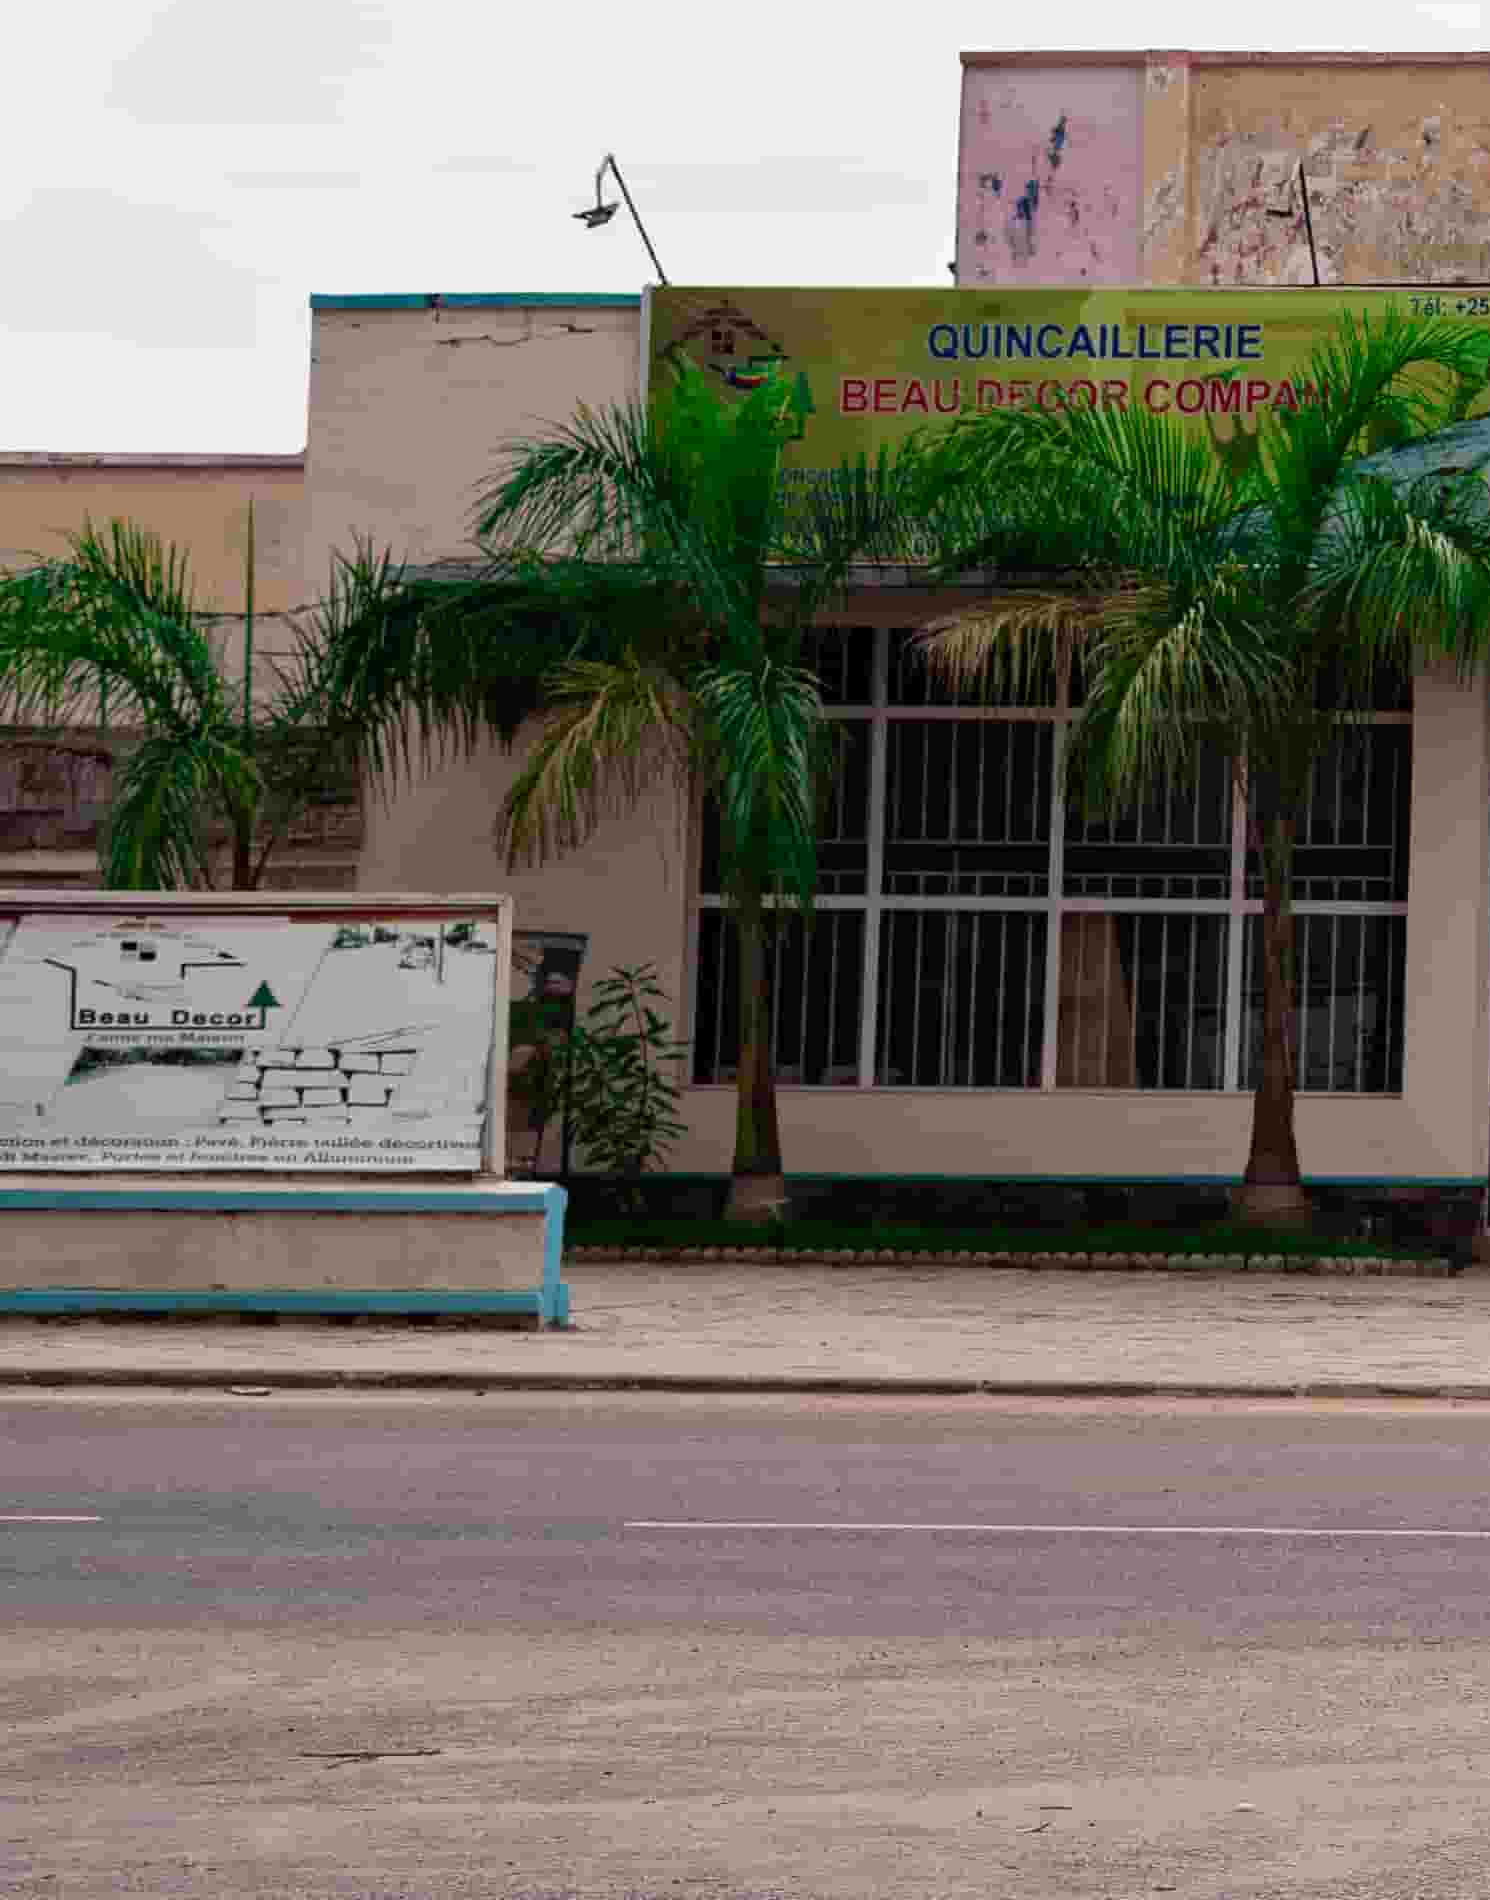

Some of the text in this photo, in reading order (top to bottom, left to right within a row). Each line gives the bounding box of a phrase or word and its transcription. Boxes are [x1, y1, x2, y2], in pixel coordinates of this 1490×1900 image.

[928, 323, 1262, 360] QUINCAILLERIE
[842, 379, 960, 412] BEAU
[79, 1008, 257, 1025] Beau Decor
